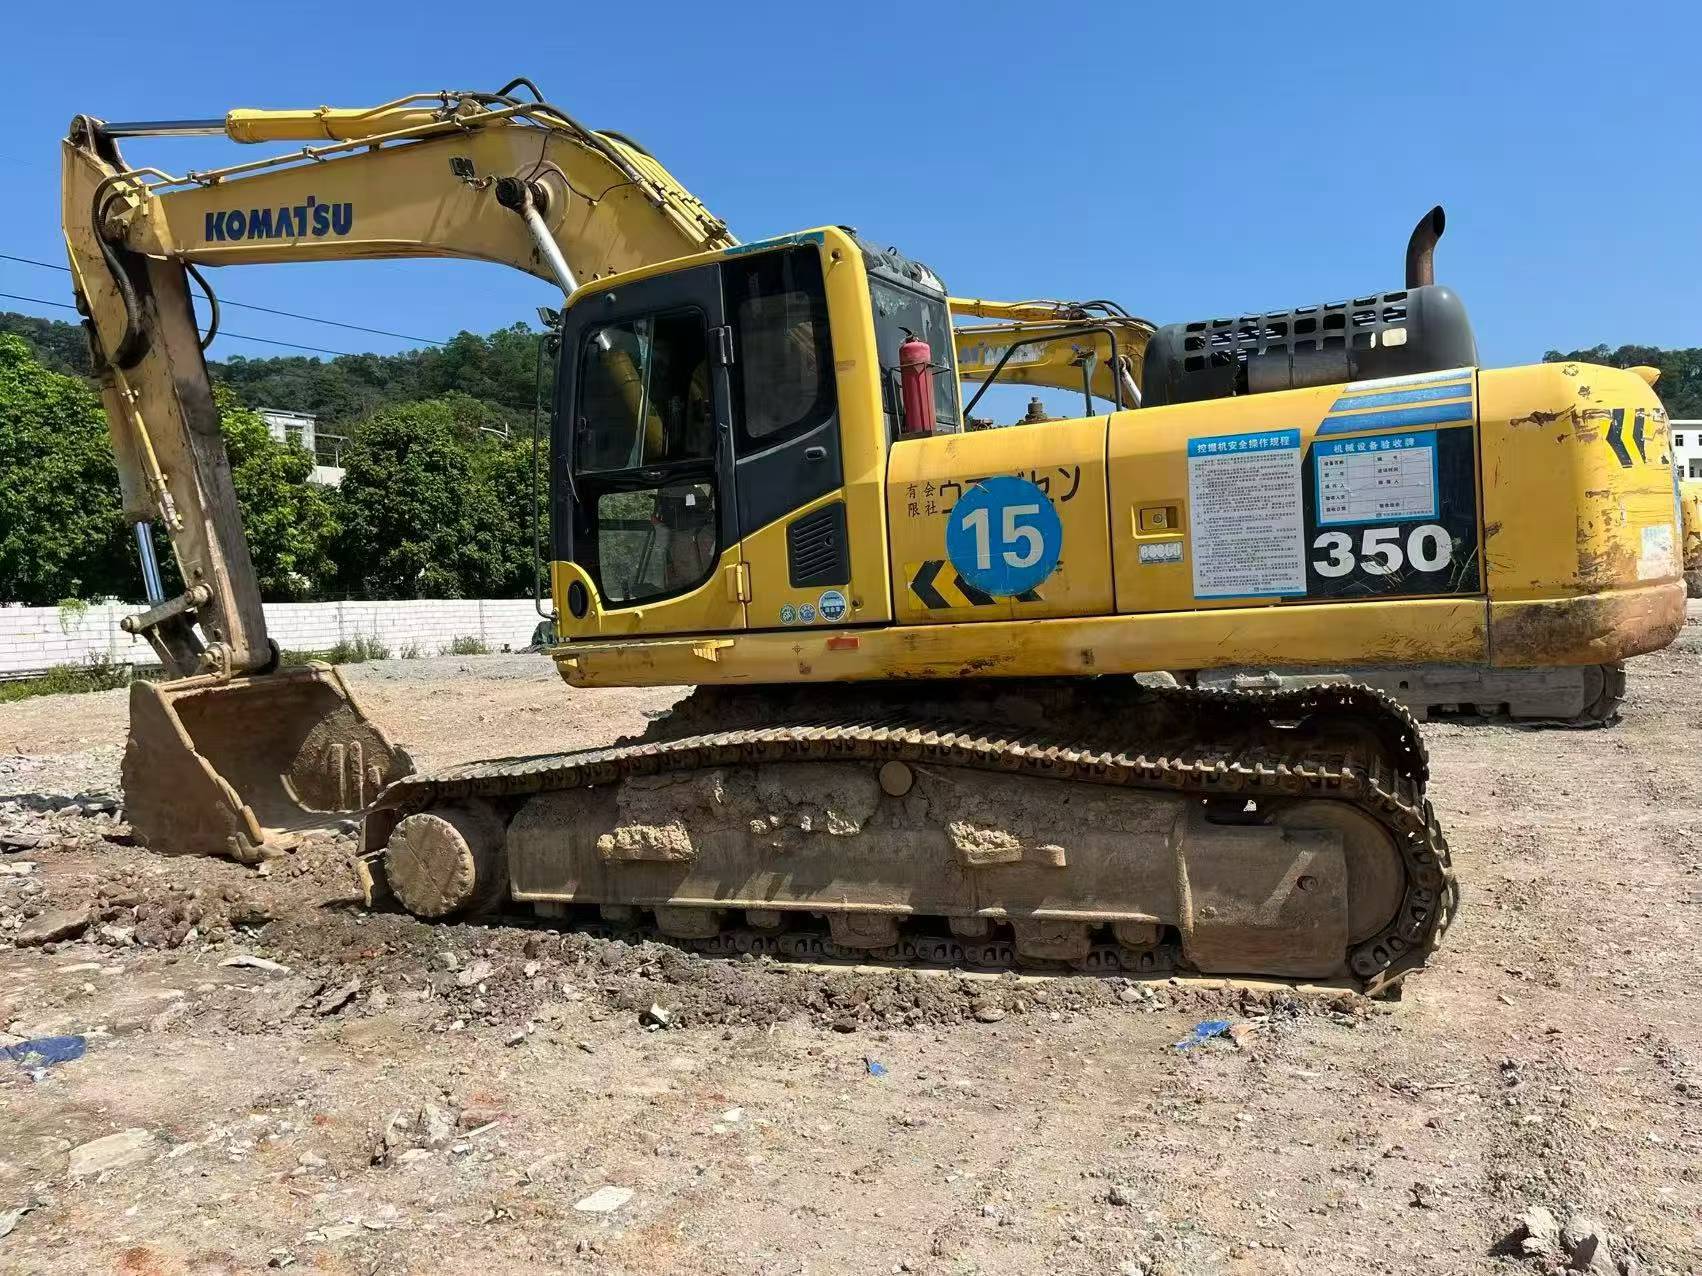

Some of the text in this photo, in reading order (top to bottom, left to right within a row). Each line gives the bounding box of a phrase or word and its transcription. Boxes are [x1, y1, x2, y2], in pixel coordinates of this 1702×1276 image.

[205, 195, 353, 242] KOMATSU
[962, 504, 1045, 569] 15
[1313, 524, 1453, 578] 350
